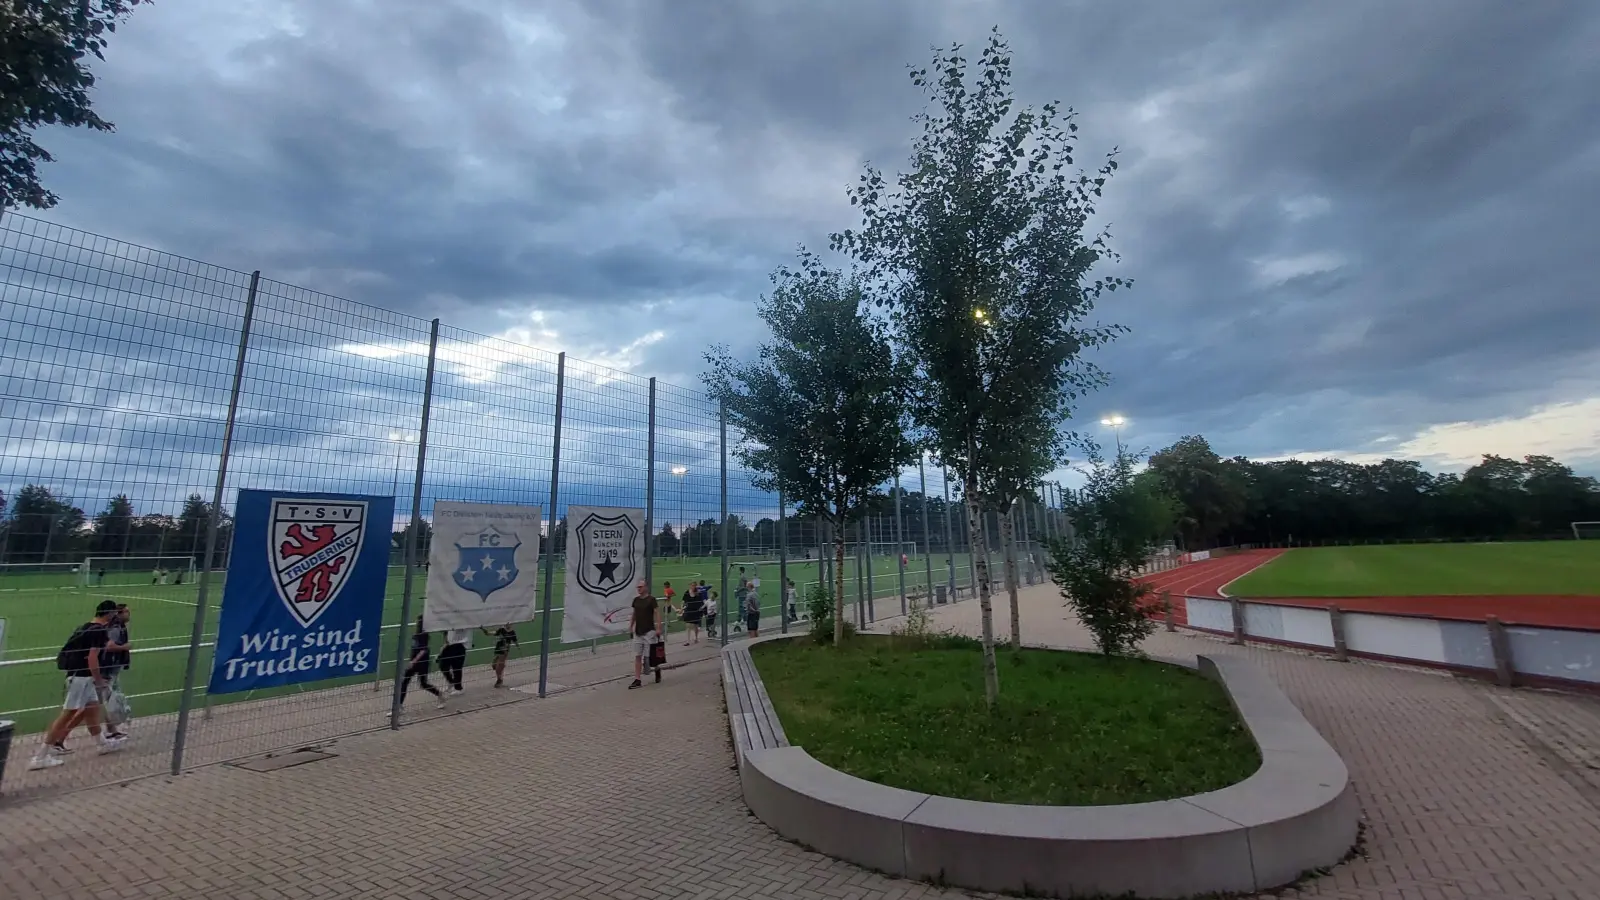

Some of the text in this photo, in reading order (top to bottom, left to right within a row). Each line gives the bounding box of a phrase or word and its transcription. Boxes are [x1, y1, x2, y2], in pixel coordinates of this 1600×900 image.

[479, 534, 501, 547] FC
[593, 530, 623, 539] STERN
[285, 537, 352, 579] TRUDERING
[240, 620, 362, 655] Wir sind
[224, 646, 371, 680] Trudering
